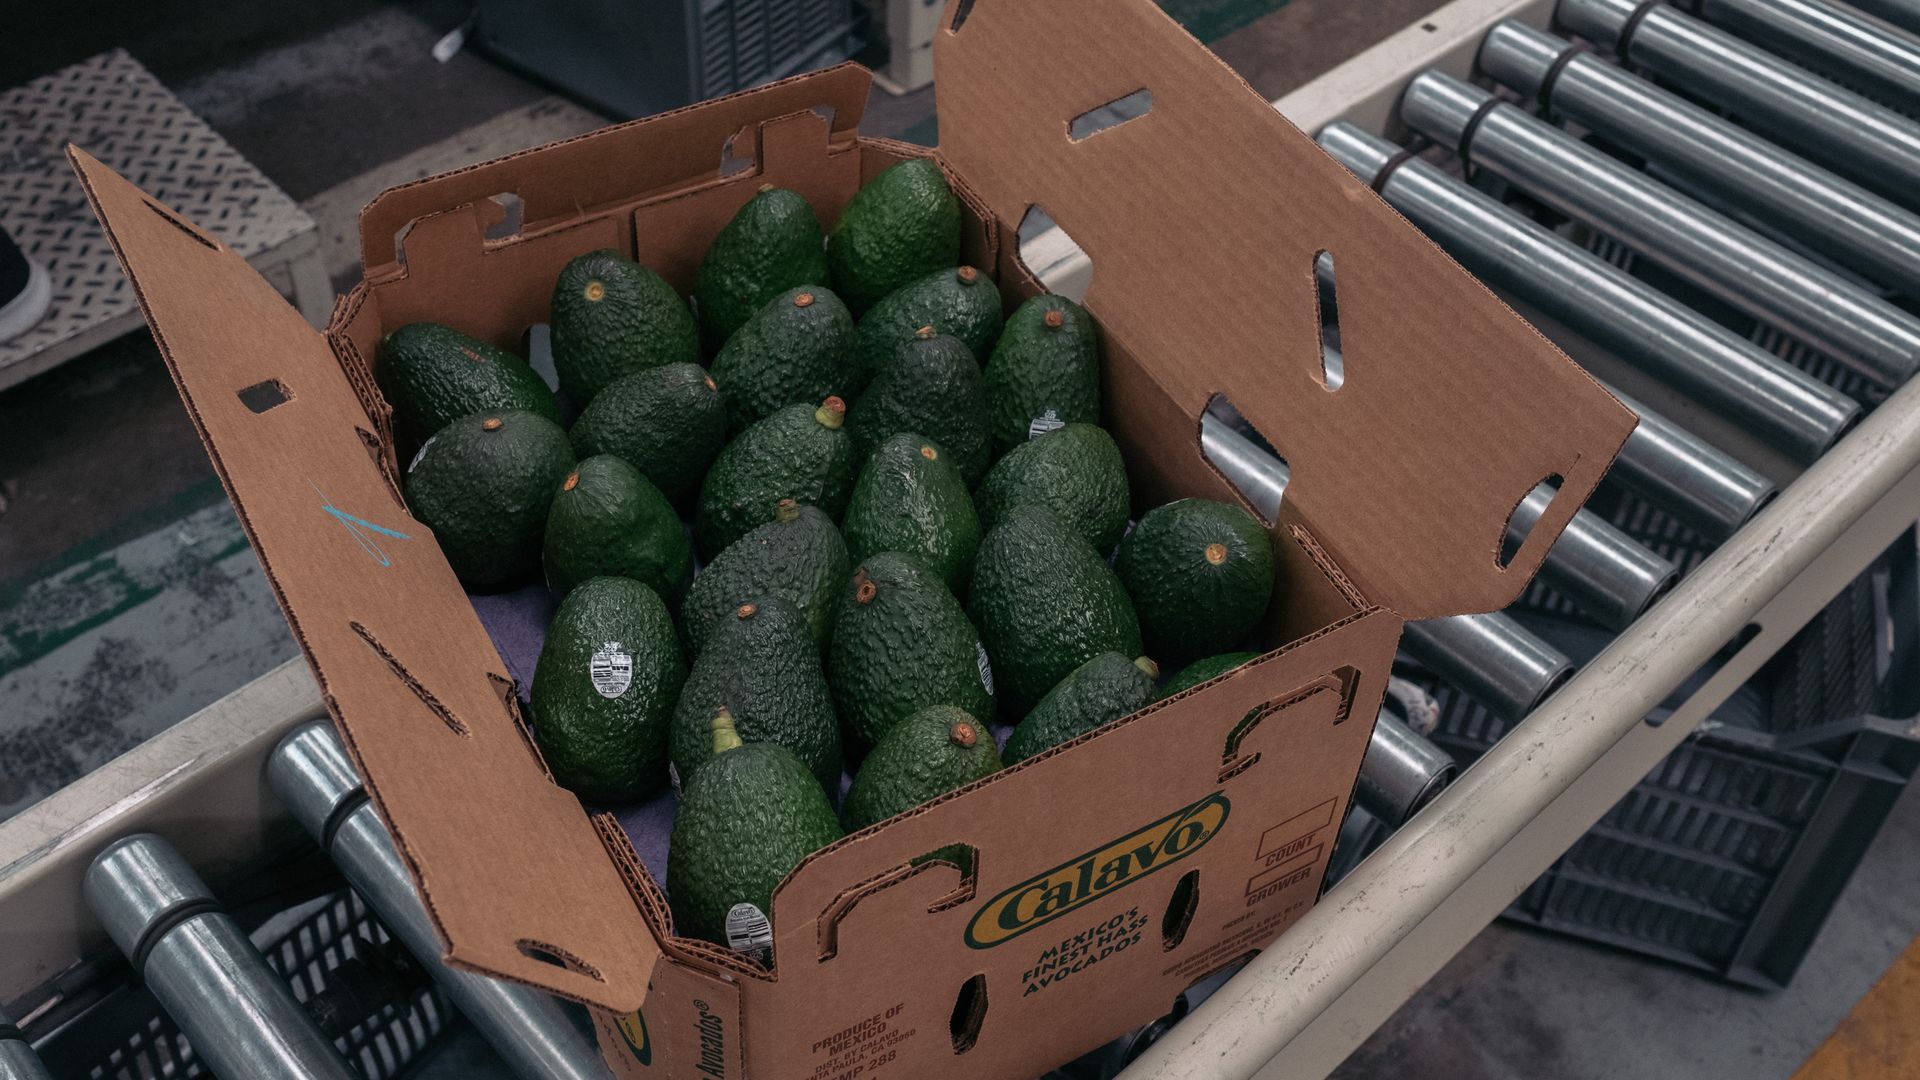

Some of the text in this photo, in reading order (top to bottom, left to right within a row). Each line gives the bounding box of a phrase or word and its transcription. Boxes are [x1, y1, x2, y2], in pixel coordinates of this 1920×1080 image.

[1265, 833, 1316, 867] COUNT
[1245, 867, 1312, 908] GROWER
[1022, 941, 1093, 984] FINEST
[1097, 914, 1149, 948] HASS
[1038, 906, 1138, 964] MEXICO'S
[1023, 932, 1142, 997] AVOCADOS
[812, 1003, 904, 1054] PRODUCE OF
[829, 1022, 887, 1056] MEXICO
[844, 1048, 858, 1060] BY
[860, 1029, 899, 1052] CALAVO
[868, 1050, 896, 1072] 288
[871, 1045, 884, 1055] CA
